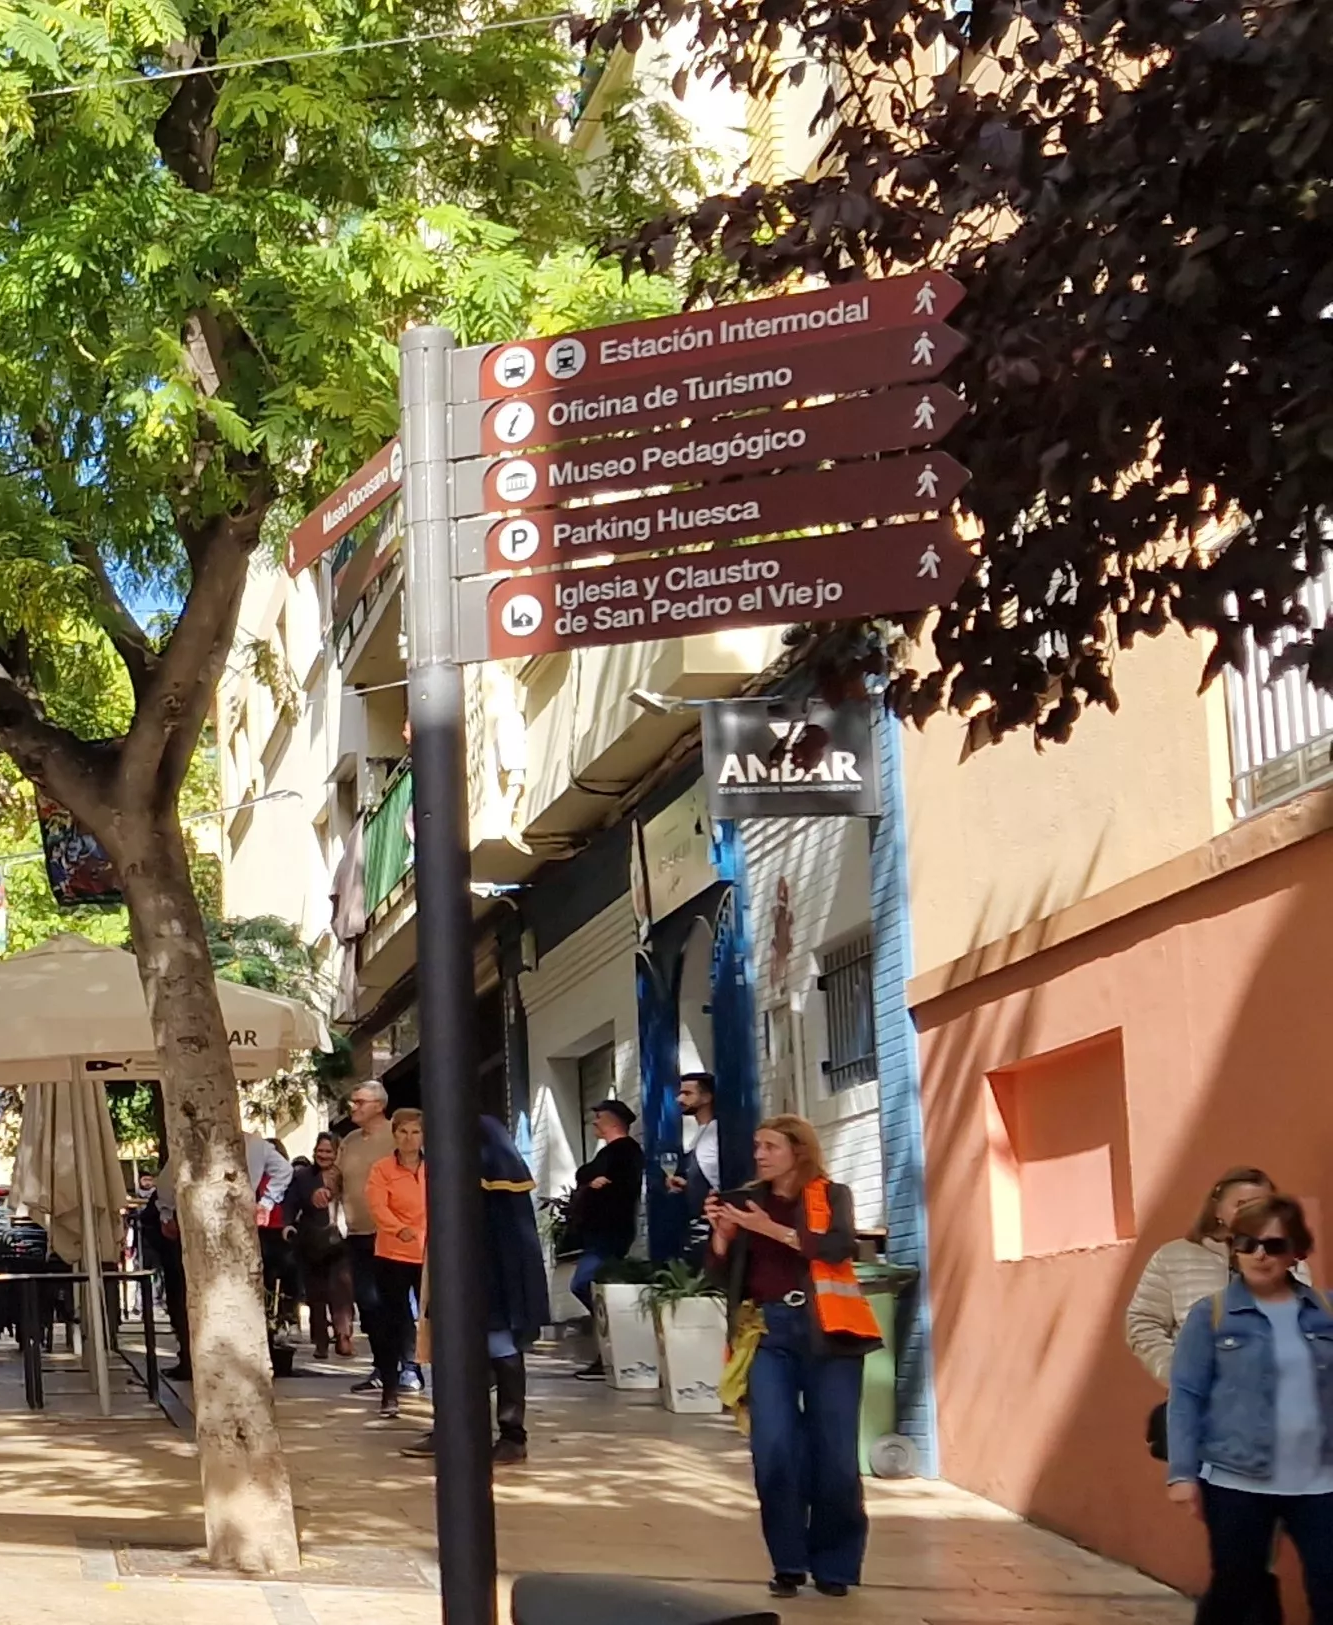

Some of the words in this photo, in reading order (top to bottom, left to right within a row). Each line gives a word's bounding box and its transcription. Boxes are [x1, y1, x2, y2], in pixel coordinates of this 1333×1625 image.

[599, 325, 713, 365] Estación
[720, 296, 869, 345] Intermodal
[548, 395, 638, 426] Oficina
[644, 385, 678, 410] de
[682, 366, 792, 402] Turismo
[548, 457, 636, 487] Museo
[642, 428, 806, 472] Pedagógico
[553, 512, 650, 547] Parking
[657, 501, 760, 532] Huesca
[554, 612, 588, 635] de
[594, 606, 644, 630] San
[652, 594, 732, 623] Pedro
[738, 584, 762, 611] el
[769, 578, 843, 608] Viejo
[555, 575, 638, 610] Iglesia
[643, 576, 660, 599] y
[665, 559, 779, 592] Claustro
